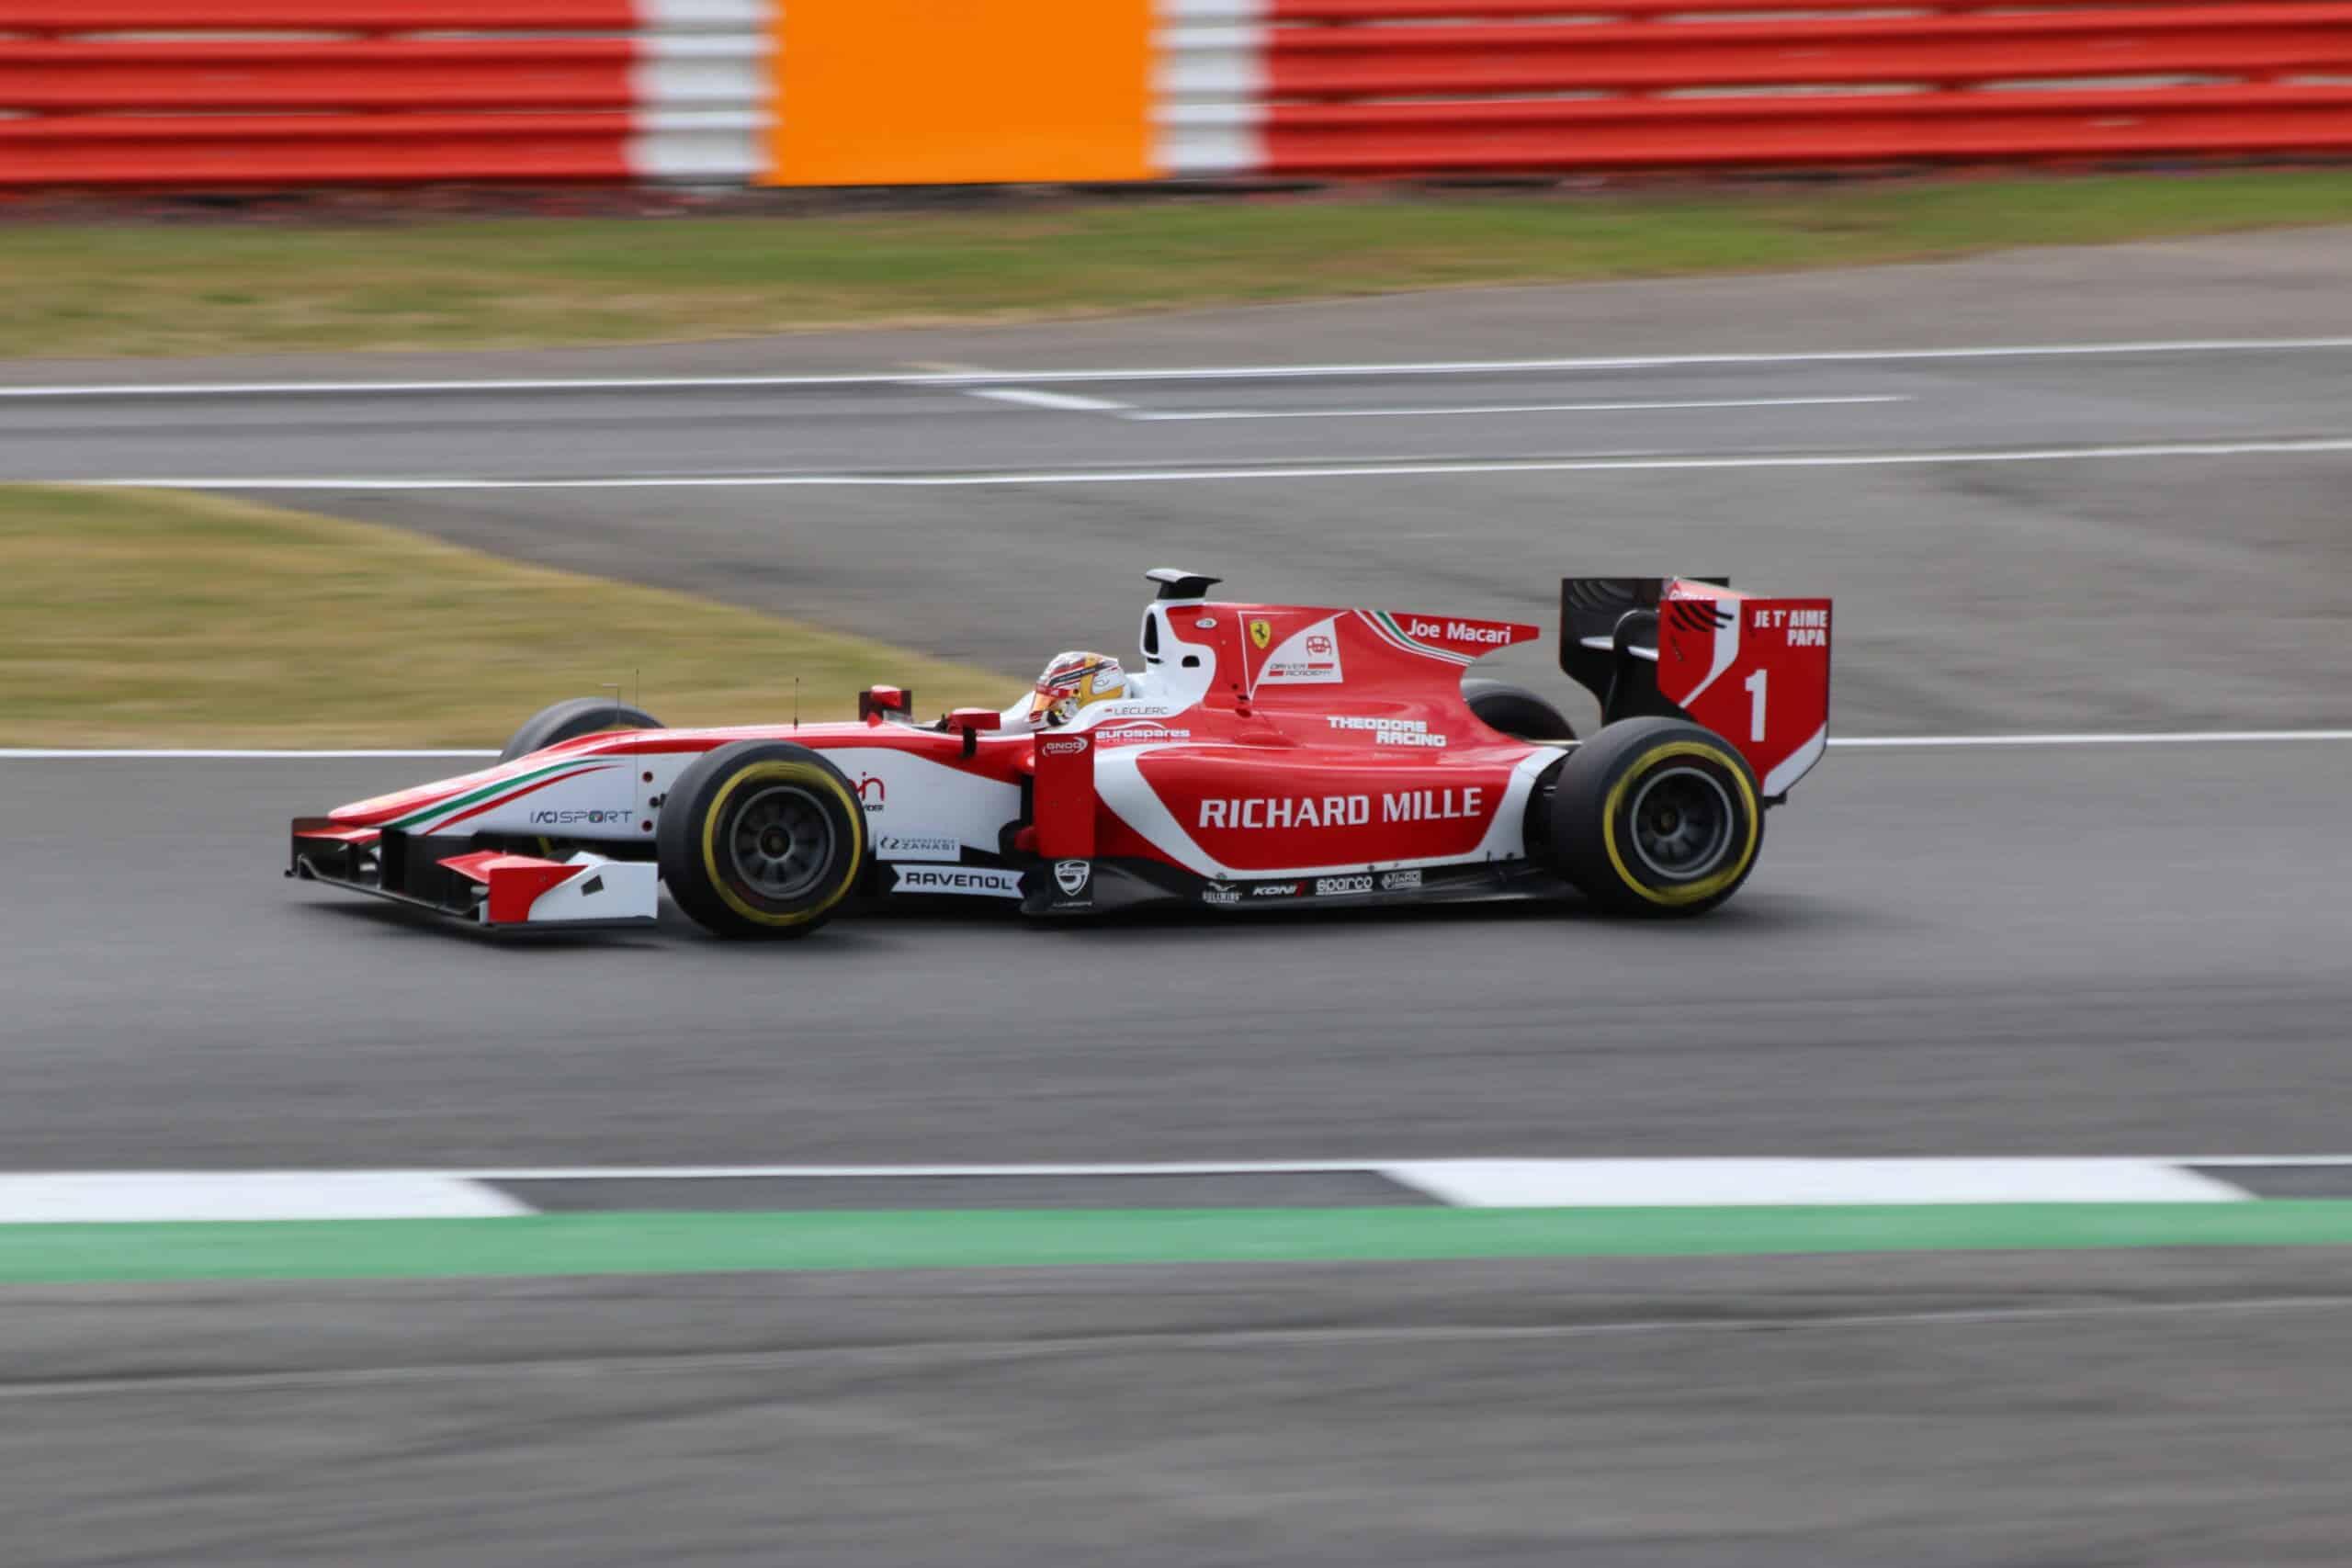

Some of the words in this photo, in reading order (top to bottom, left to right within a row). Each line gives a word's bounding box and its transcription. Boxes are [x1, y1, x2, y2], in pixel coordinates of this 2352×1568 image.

[1754, 610, 1770, 628] JE
[1789, 610, 1828, 628] AIME
[1408, 618, 1442, 638] Joe
[1447, 622, 1511, 645] Macari
[1787, 629, 1826, 647] PAPA
[1115, 706, 1169, 715] LECLERC
[1745, 669, 1768, 742] 1
[1327, 716, 1427, 733] THEODORE
[1095, 729, 1191, 739] eurospares
[1376, 730, 1447, 747] RACING
[1197, 795, 1370, 829] RICHARD
[1382, 786, 1483, 823] MILLE
[905, 872, 1013, 891] RAVENOL
[1316, 875, 1374, 895] sparco
[1253, 886, 1298, 897] KONI
